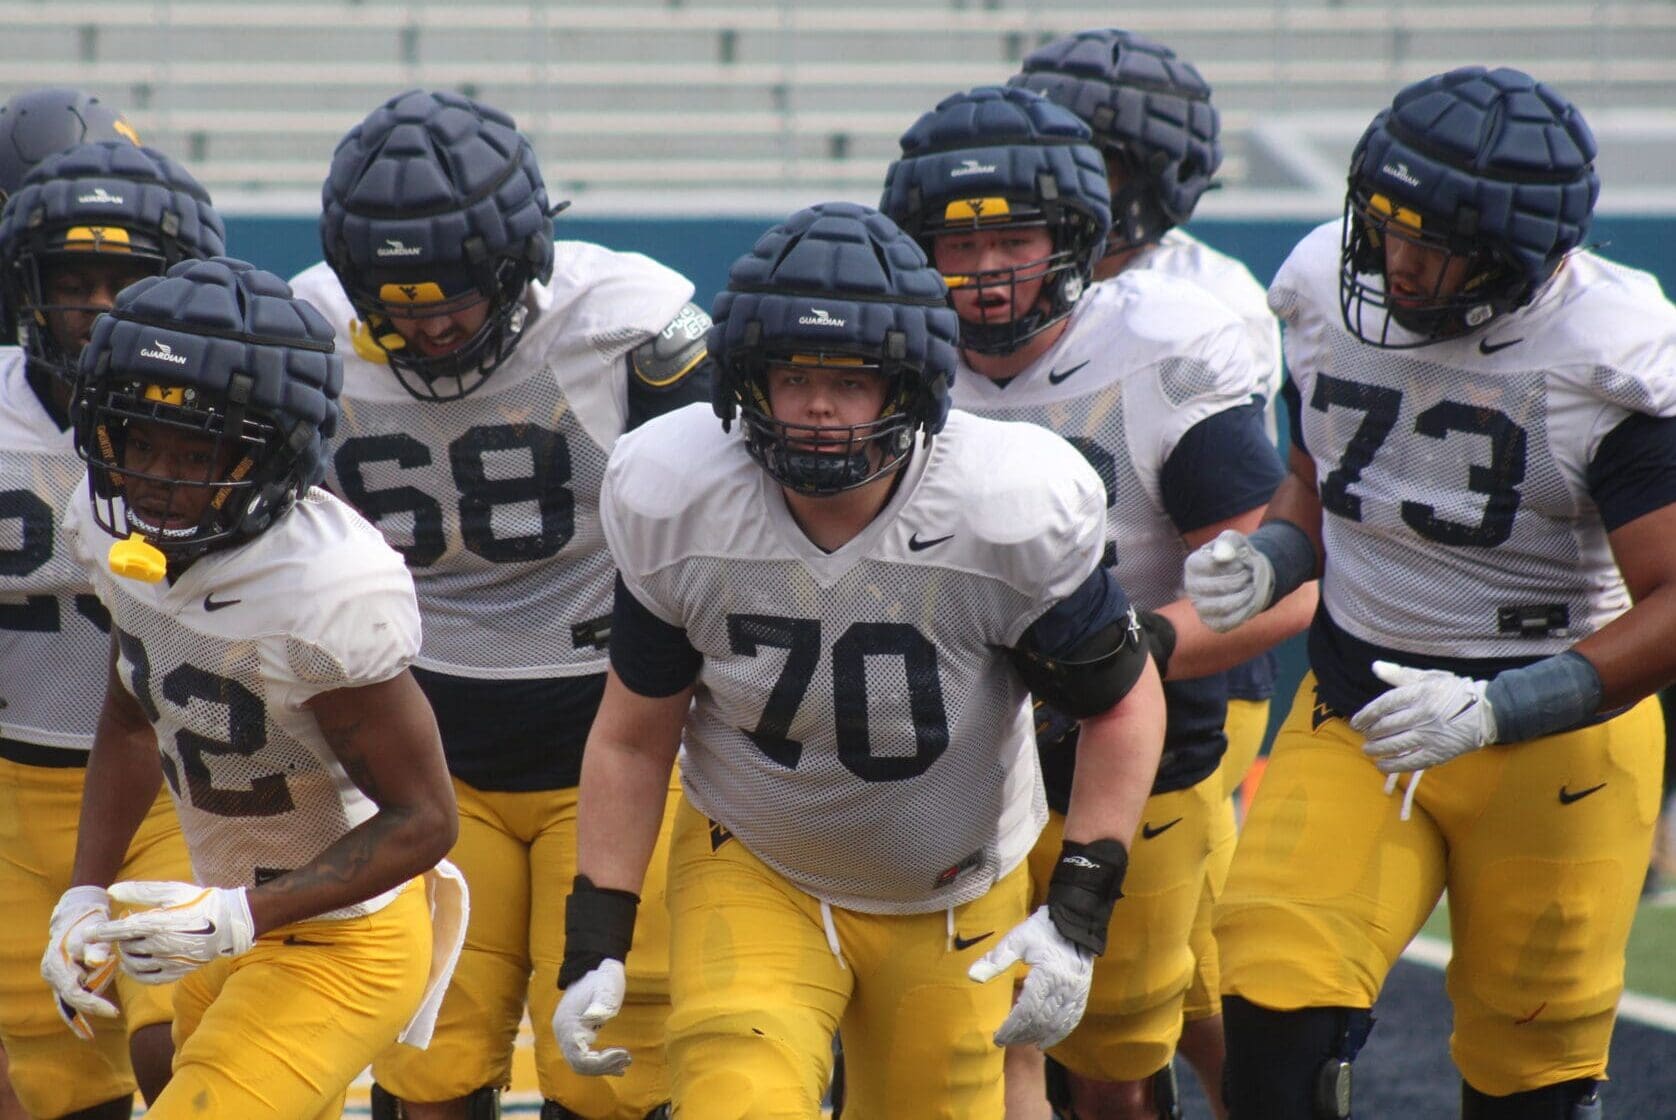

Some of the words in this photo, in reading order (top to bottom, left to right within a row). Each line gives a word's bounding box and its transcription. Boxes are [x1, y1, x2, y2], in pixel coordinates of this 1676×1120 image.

[140, 347, 187, 365] GUARDIAN
[798, 316, 846, 328] GUARDIAN
[333, 422, 575, 564] 68
[1310, 372, 1528, 549] 73
[726, 612, 950, 783] 70
